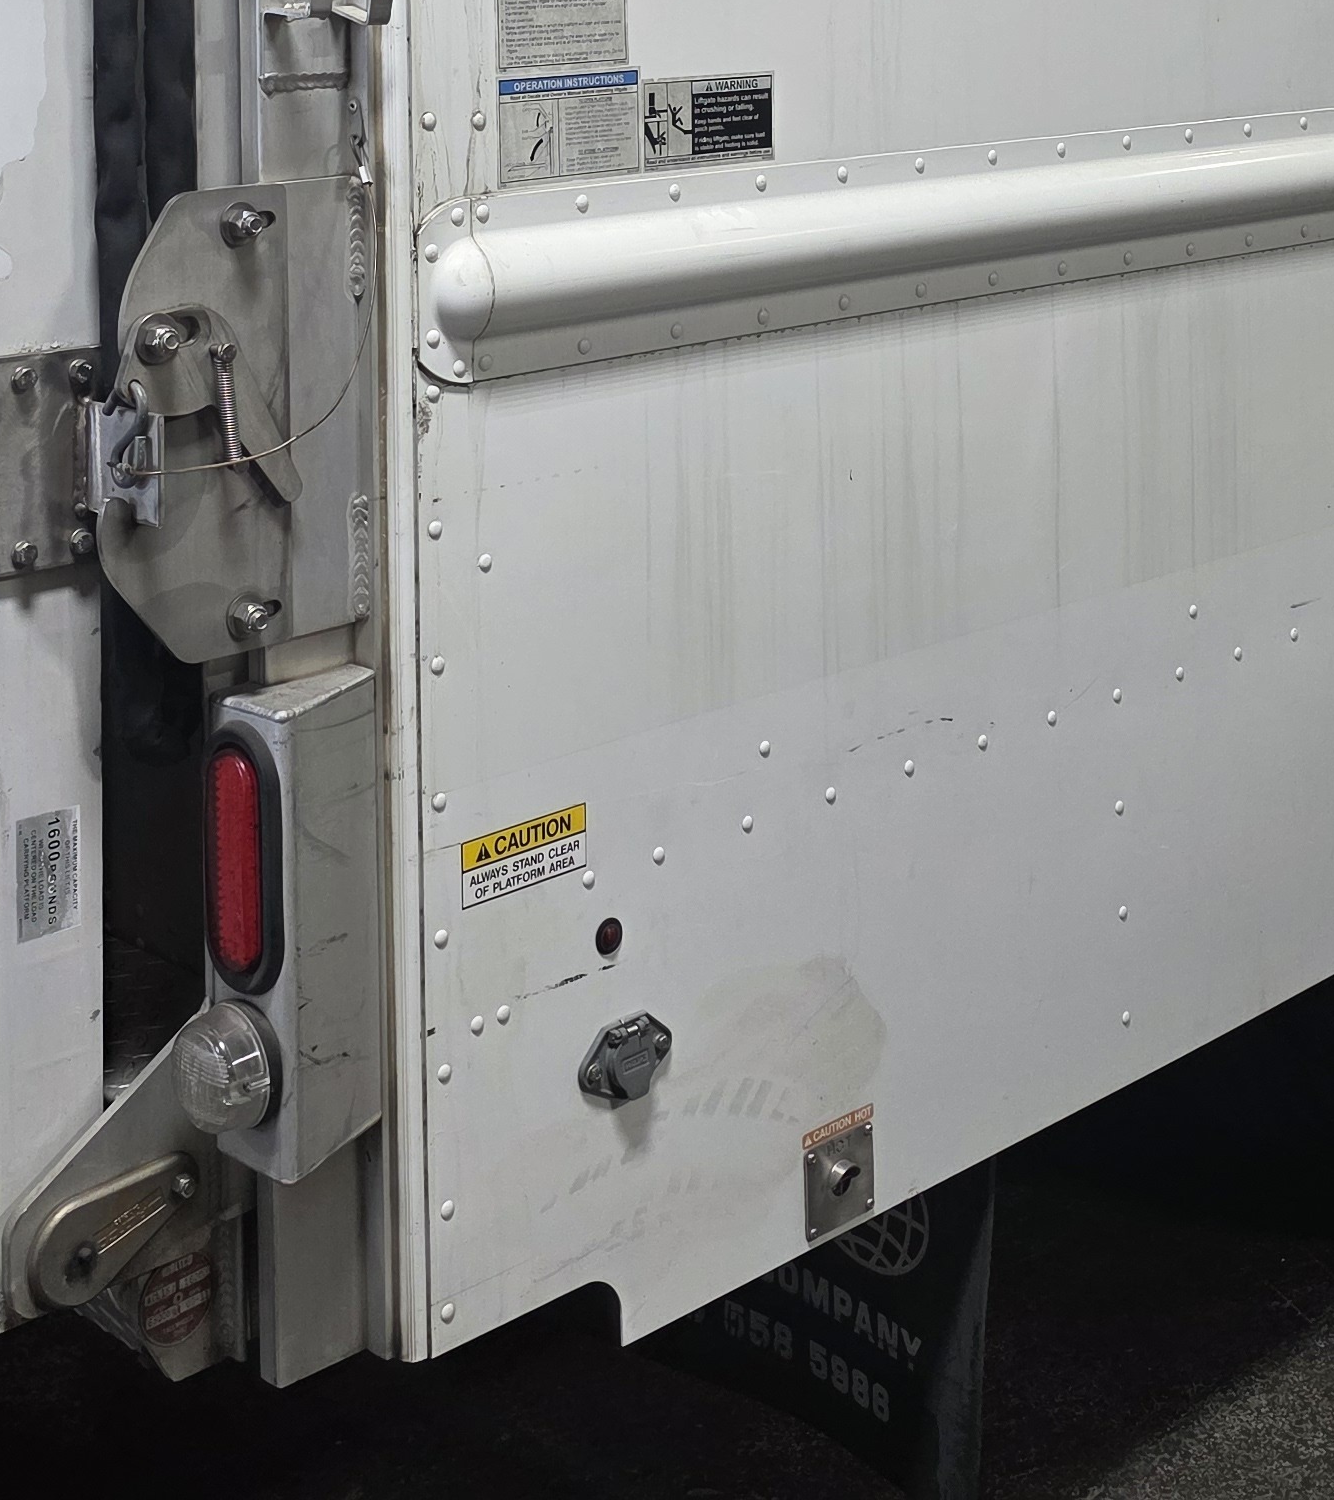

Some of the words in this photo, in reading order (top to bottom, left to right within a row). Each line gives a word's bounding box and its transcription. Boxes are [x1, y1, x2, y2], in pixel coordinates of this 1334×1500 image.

[514, 79, 563, 91] OPERATION
[564, 75, 624, 87] INSTRUCTIONS
[715, 79, 758, 91] WARNING
[47, 816, 61, 862] 1600
[495, 813, 571, 855] CAUTION
[31, 872, 37, 883] ON
[469, 864, 508, 887] ALWAYS
[512, 852, 545, 872] STAND
[548, 840, 580, 859] CLEAR
[475, 886, 489, 899] OF
[493, 866, 545, 893] PLATFORM
[549, 856, 575, 874] AREA
[47, 864, 57, 925] POUNDS
[813, 1115, 852, 1143] CAUTION
[854, 1105, 873, 1122] HOT
[825, 1135, 854, 1156] HOT
[762, 1263, 922, 1372] OMPANY
